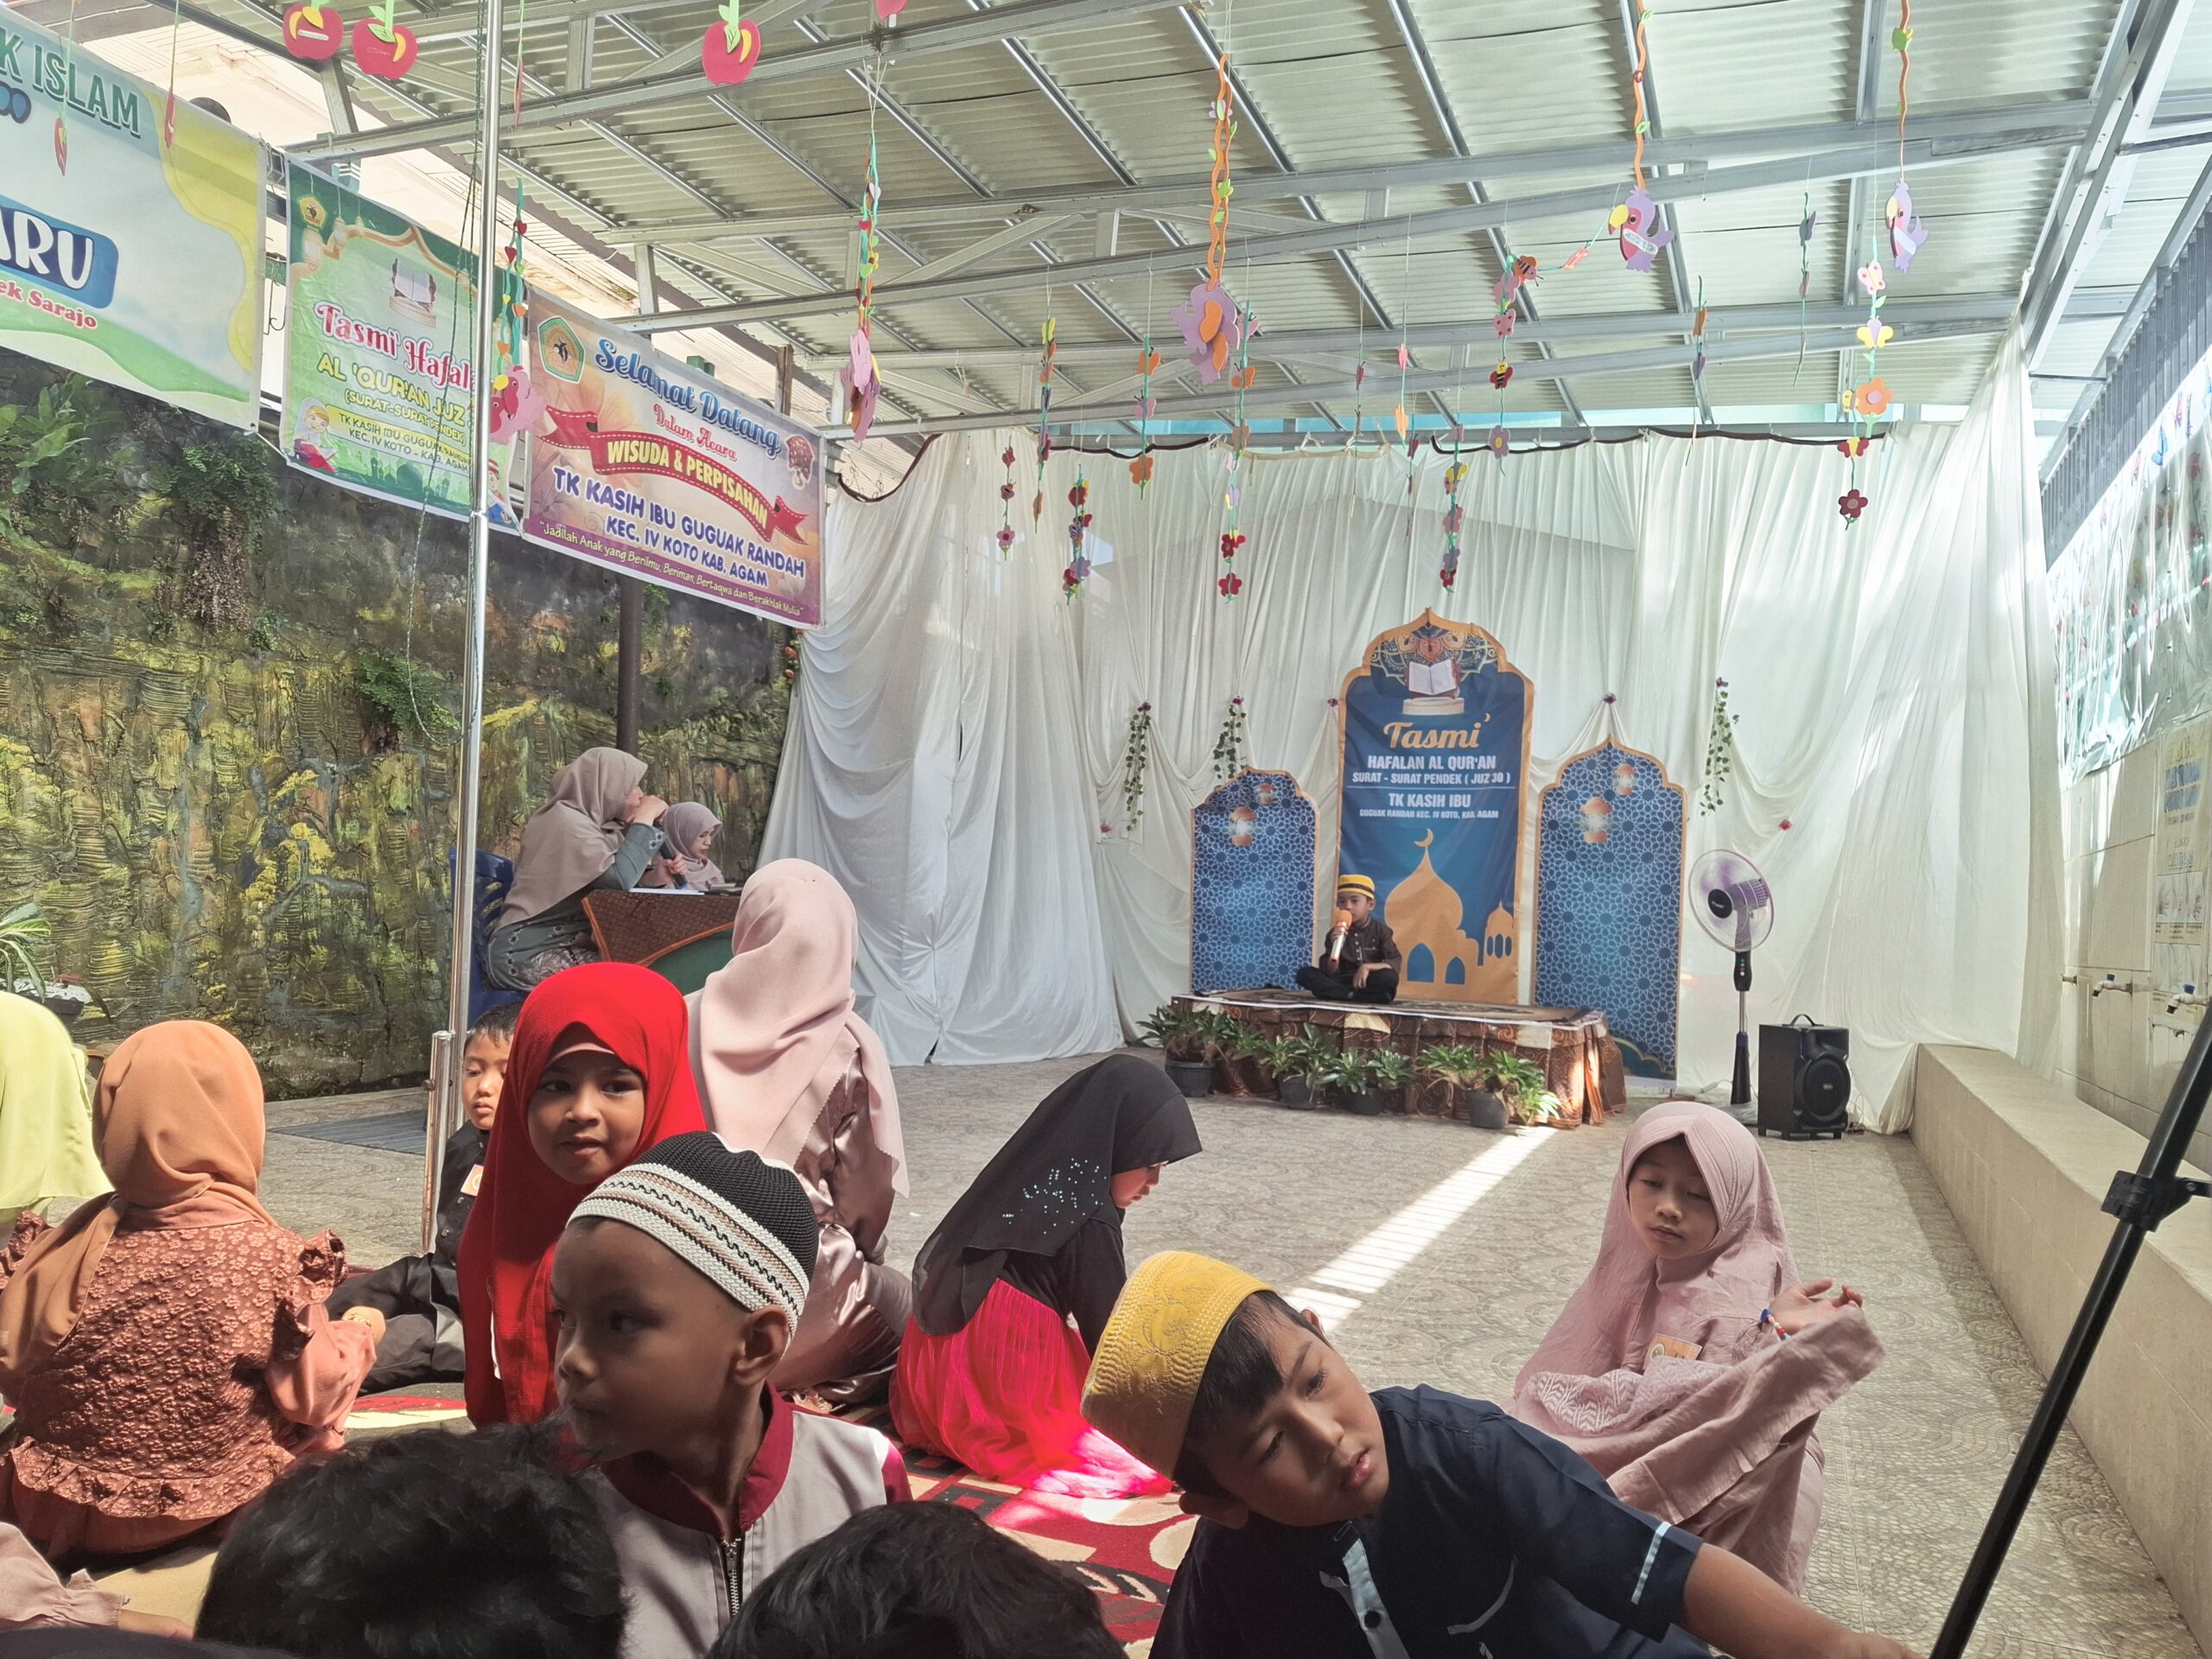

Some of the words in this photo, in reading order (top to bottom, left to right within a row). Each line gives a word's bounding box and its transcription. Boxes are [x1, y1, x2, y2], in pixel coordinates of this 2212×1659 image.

[33, 44, 140, 139] ISLAM
[28, 290, 97, 327] Sarajo
[317, 353, 346, 382] AL
[433, 397, 466, 428] JUZ
[339, 412, 351, 425] TK
[353, 418, 381, 435] KASIH
[383, 428, 401, 440] IBU
[653, 404, 695, 443] Dalam
[700, 390, 781, 459] Datang
[349, 429, 370, 442] KEC.
[372, 435, 382, 446] IV
[385, 439, 412, 455] KOTO
[421, 449, 443, 465] KAB.
[607, 440, 670, 467] WISUDA
[674, 449, 683, 473] &
[686, 455, 768, 529] PERPISAHAN
[554, 467, 580, 496] TK
[586, 479, 645, 518] KASIH
[650, 502, 676, 529] IBU
[681, 516, 744, 556] GUGUAK
[747, 542, 804, 577] RANDAH
[580, 535, 603, 552] Anak
[605, 545, 626, 562] yang
[628, 551, 662, 573] Berilmu,
[663, 563, 696, 584] Beriman,
[696, 575, 732, 596] Bertaqwa
[734, 588, 747, 599] dan
[607, 516, 639, 542] KEC.
[645, 528, 660, 548] IV
[663, 535, 698, 562] KOTO
[702, 550, 726, 574] KAB.
[729, 562, 768, 587] AGAM
[1352, 772, 1382, 783] SURAT
[1390, 772, 1422, 784] SURAT
[1424, 772, 1462, 785] PENDEK
[1471, 772, 1489, 784] JUZ
[1491, 772, 1503, 783] 30
[1368, 755, 1425, 770] HAFALAN
[1428, 755, 1444, 769] AL
[1448, 755, 1496, 771] QUR'AN
[1389, 792, 1404, 806] TK
[1408, 793, 1446, 807] KASIH
[1449, 793, 1471, 807] IBU
[1478, 810, 1499, 818] AGAM
